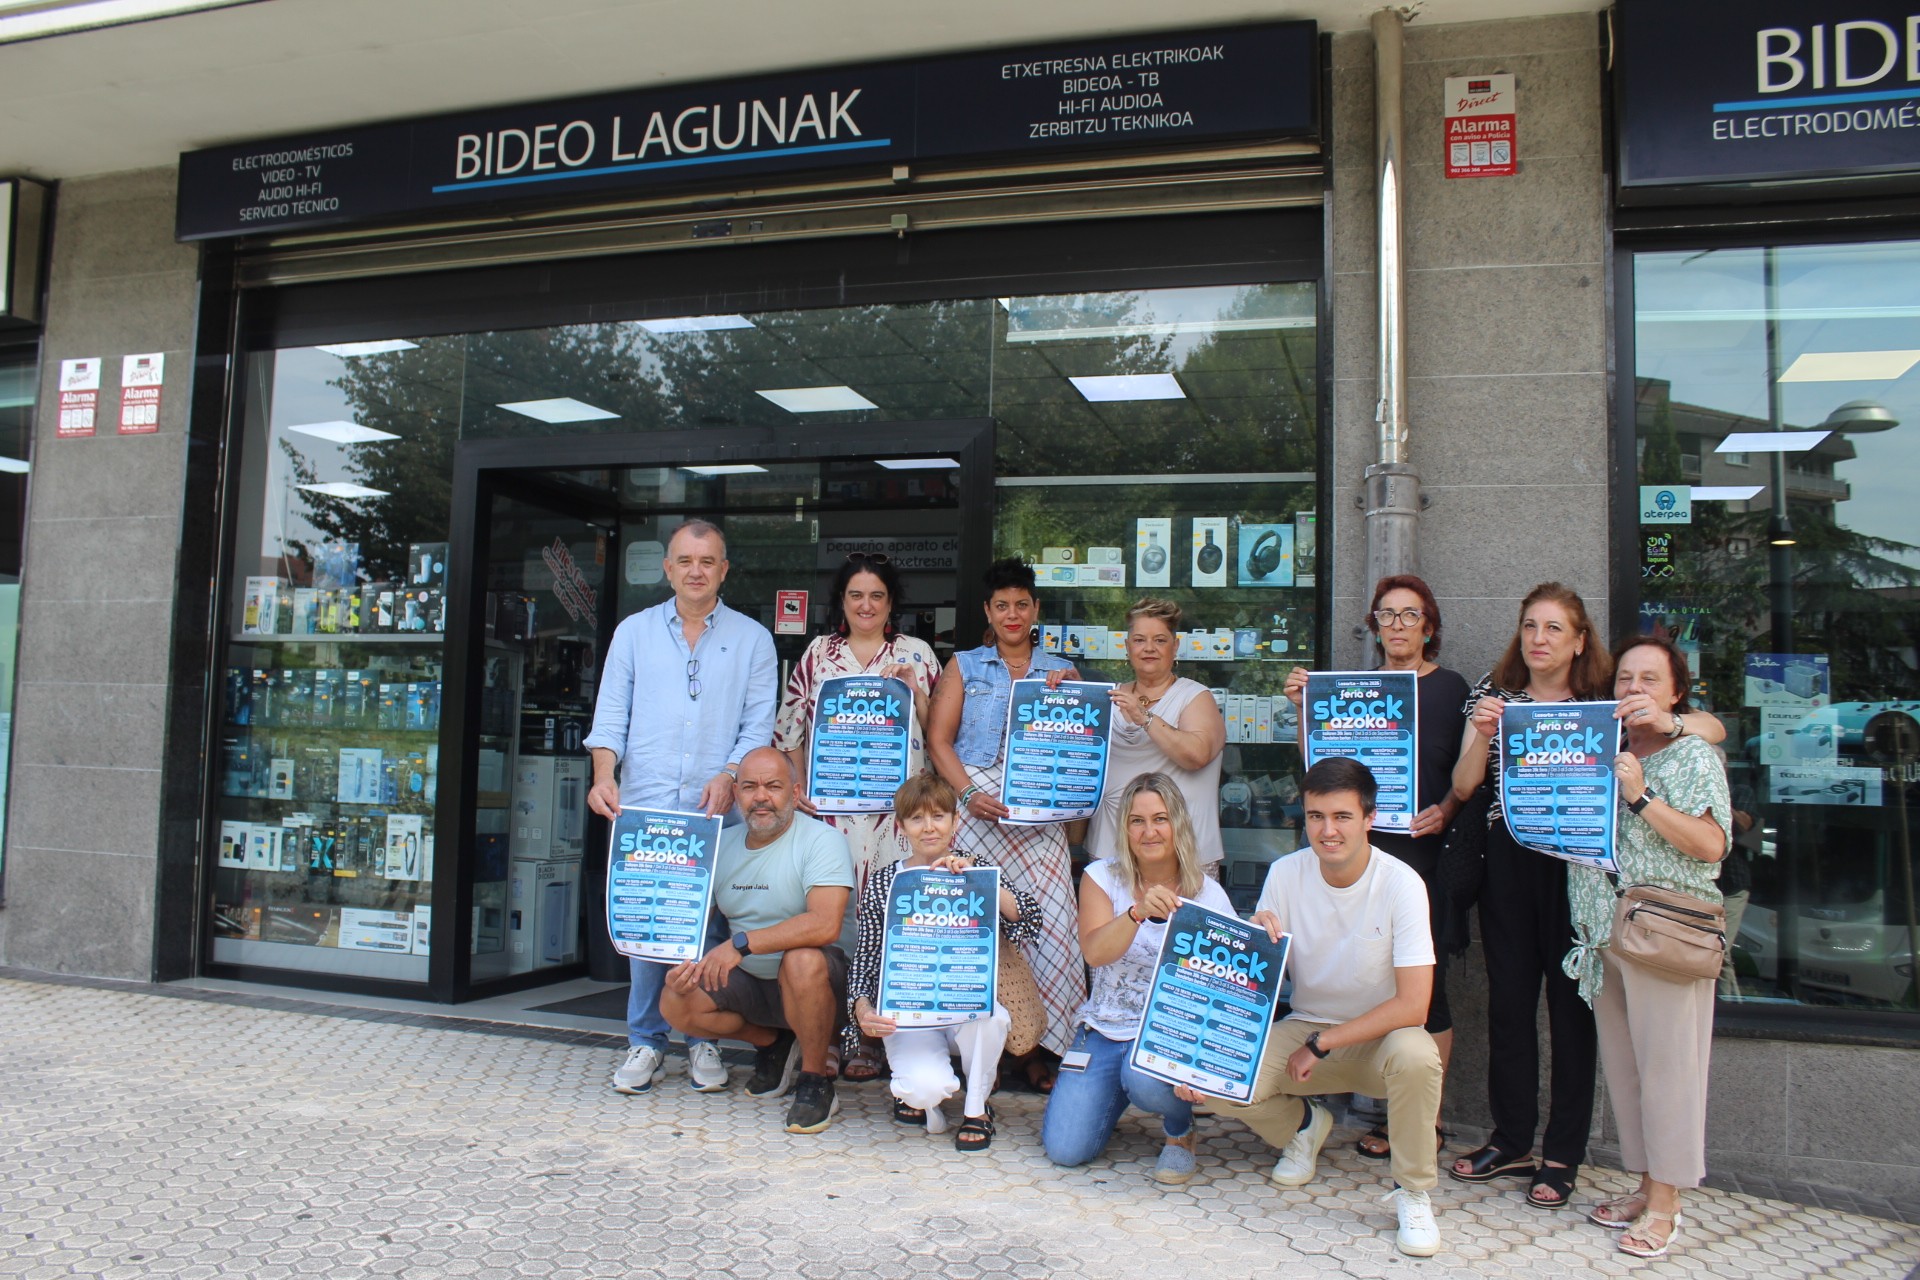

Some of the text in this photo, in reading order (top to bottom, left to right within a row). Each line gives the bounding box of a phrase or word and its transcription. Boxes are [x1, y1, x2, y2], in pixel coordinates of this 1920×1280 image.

[1001, 45, 1224, 79] ETXETRESNA ELEKTRIKOAK
[1063, 76, 1122, 94] BIDEOA
[1139, 72, 1159, 86] TB
[1058, 93, 1163, 115] HI-FI AUDIOA
[456, 89, 862, 179] BIDEO LAGUNAK
[1029, 112, 1193, 138] ZERBITZU TEKNIKOA
[1451, 119, 1510, 133] Alarma
[232, 143, 353, 171] ELECTRODOMÉSTICOS
[262, 168, 295, 184] VIDEO
[306, 166, 321, 179] TV
[258, 183, 322, 201] AUDIO HI-FI
[239, 198, 339, 221] SERVICIO TÉCNICO
[62, 392, 95, 403] Alarma
[124, 388, 158, 400] Alarma
[1644, 510, 1687, 519] aterpea
[827, 540, 884, 553] pequeño
[888, 540, 938, 552] aparato
[846, 689, 880, 698] feria de
[1043, 696, 1079, 705] feria de
[1339, 689, 1379, 700] feria de
[823, 694, 900, 717] stock
[1018, 701, 1100, 727] stock
[1313, 695, 1403, 720] stock
[836, 711, 886, 725] azoka
[1032, 719, 1085, 734] azoka
[1330, 714, 1388, 729] azoka
[1535, 721, 1578, 732] feria de
[1509, 727, 1604, 756] stock
[1525, 748, 1586, 765] azoka
[646, 825, 684, 836] feria de
[620, 829, 705, 858] stock
[633, 849, 688, 865] azoka
[923, 885, 964, 896] feria de
[896, 890, 984, 917] stock
[911, 912, 970, 927] azoka
[1206, 928, 1245, 951] feria de
[1173, 931, 1268, 983] stock
[1188, 956, 1249, 987] azoka
